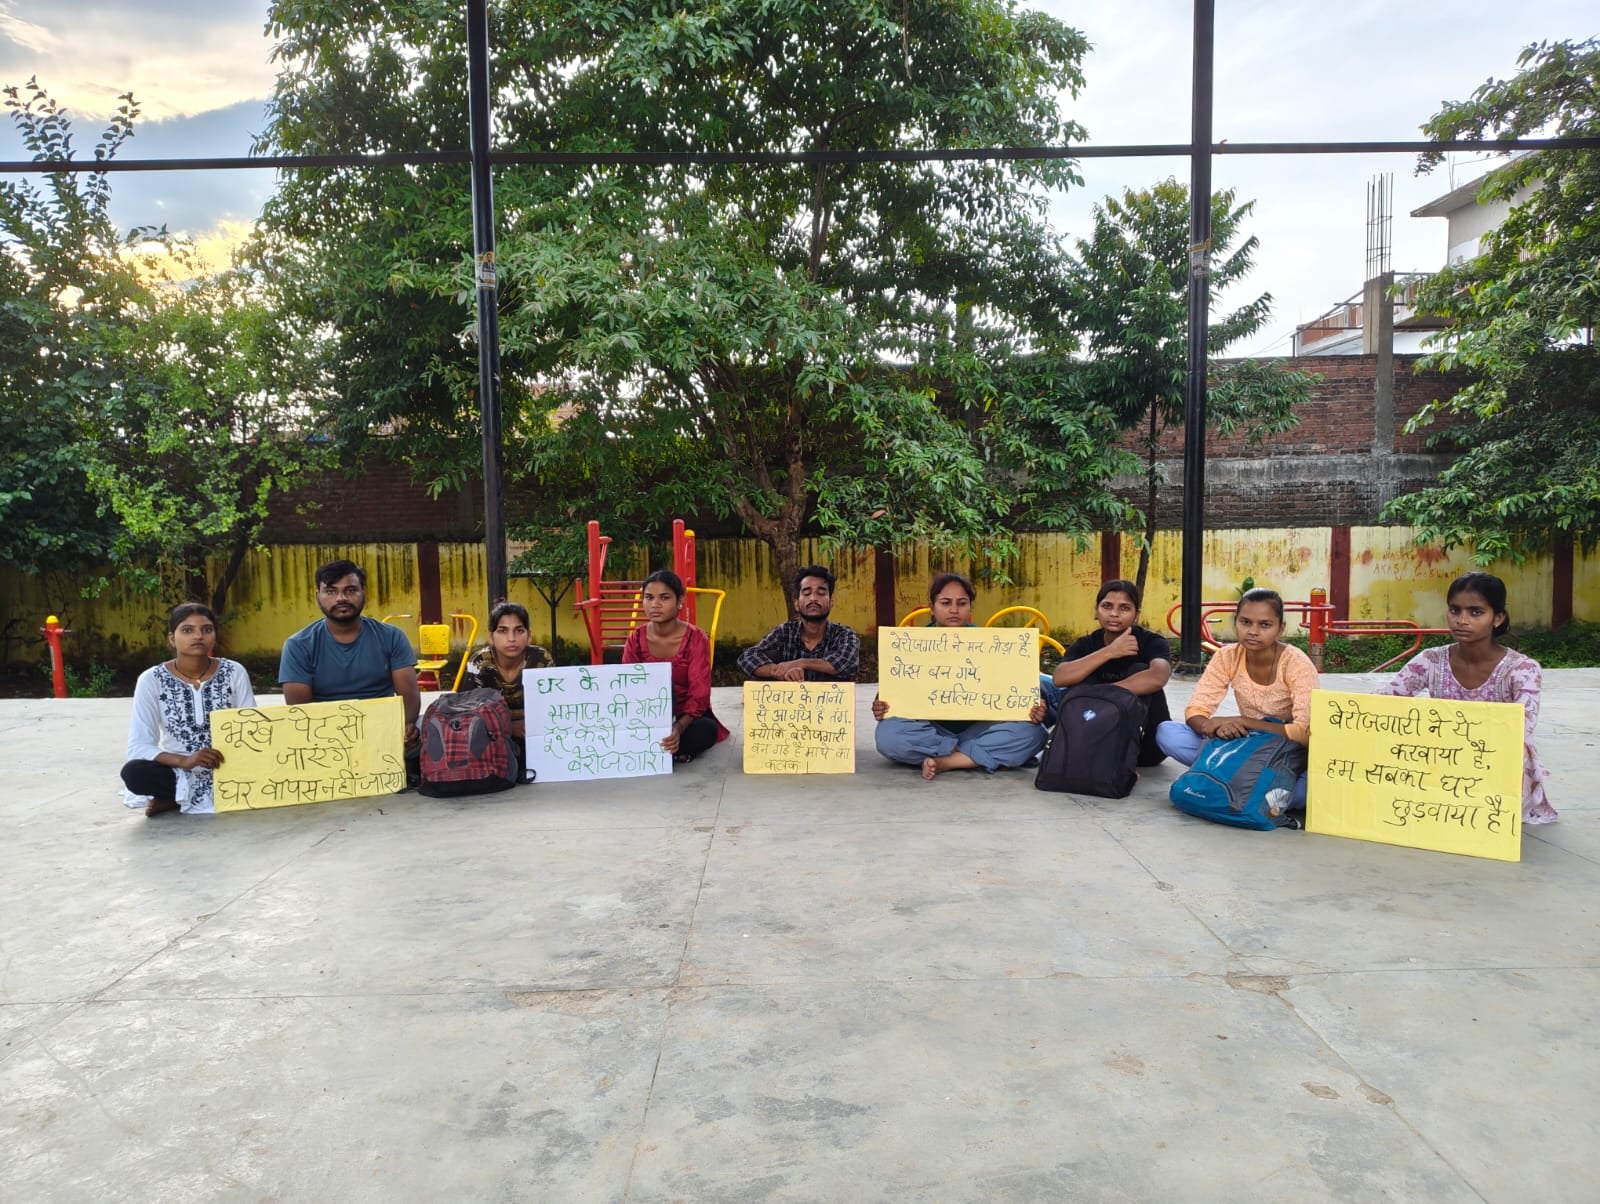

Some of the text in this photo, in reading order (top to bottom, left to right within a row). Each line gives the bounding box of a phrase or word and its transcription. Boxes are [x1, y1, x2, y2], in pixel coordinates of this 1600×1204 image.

[952, 633, 963, 653] ने
[579, 667, 599, 691] के
[610, 664, 650, 690] ताने
[928, 665, 952, 679] बन
[548, 687, 672, 724] समाज की गाली
[752, 684, 796, 704] परिवार
[800, 684, 815, 704] के
[928, 683, 978, 706] इसलिए
[982, 694, 1003, 710] घर
[756, 704, 771, 722] से
[772, 709, 788, 722] आ
[790, 704, 812, 724] गये
[1428, 709, 1452, 738] ने
[1452, 711, 1482, 741] ये
[221, 704, 366, 752] भूखे पेट सो
[543, 717, 654, 759] दूर करो ये
[788, 723, 848, 742] बेरोजगारी
[568, 741, 665, 775] बेरोजगारी
[752, 743, 769, 755] बन
[835, 747, 850, 760] का
[1390, 743, 1463, 766] करवाया
[218, 781, 256, 809] घर
[261, 778, 322, 801] वापस
[322, 769, 367, 799] नहीं
[1326, 758, 1484, 798] हम सबका घर
